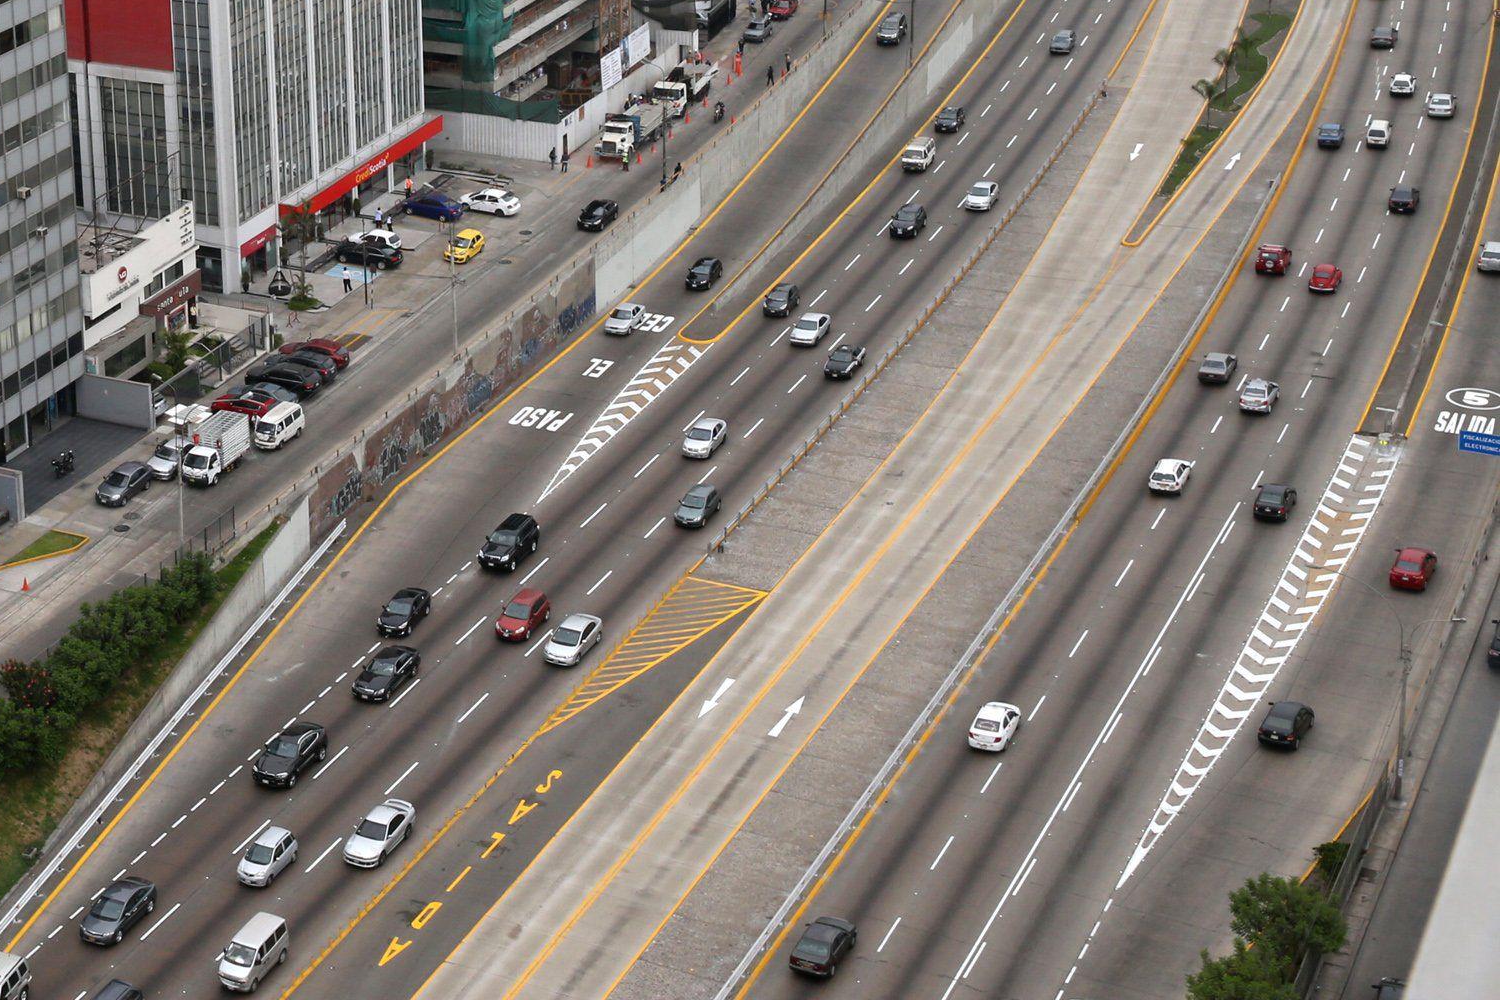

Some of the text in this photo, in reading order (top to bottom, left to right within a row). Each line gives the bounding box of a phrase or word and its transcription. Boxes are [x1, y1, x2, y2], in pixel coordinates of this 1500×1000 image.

[581, 357, 615, 378] EL
[1462, 391, 1490, 406] 5
[508, 405, 574, 432] PASO
[1434, 411, 1496, 435] SALIDA
